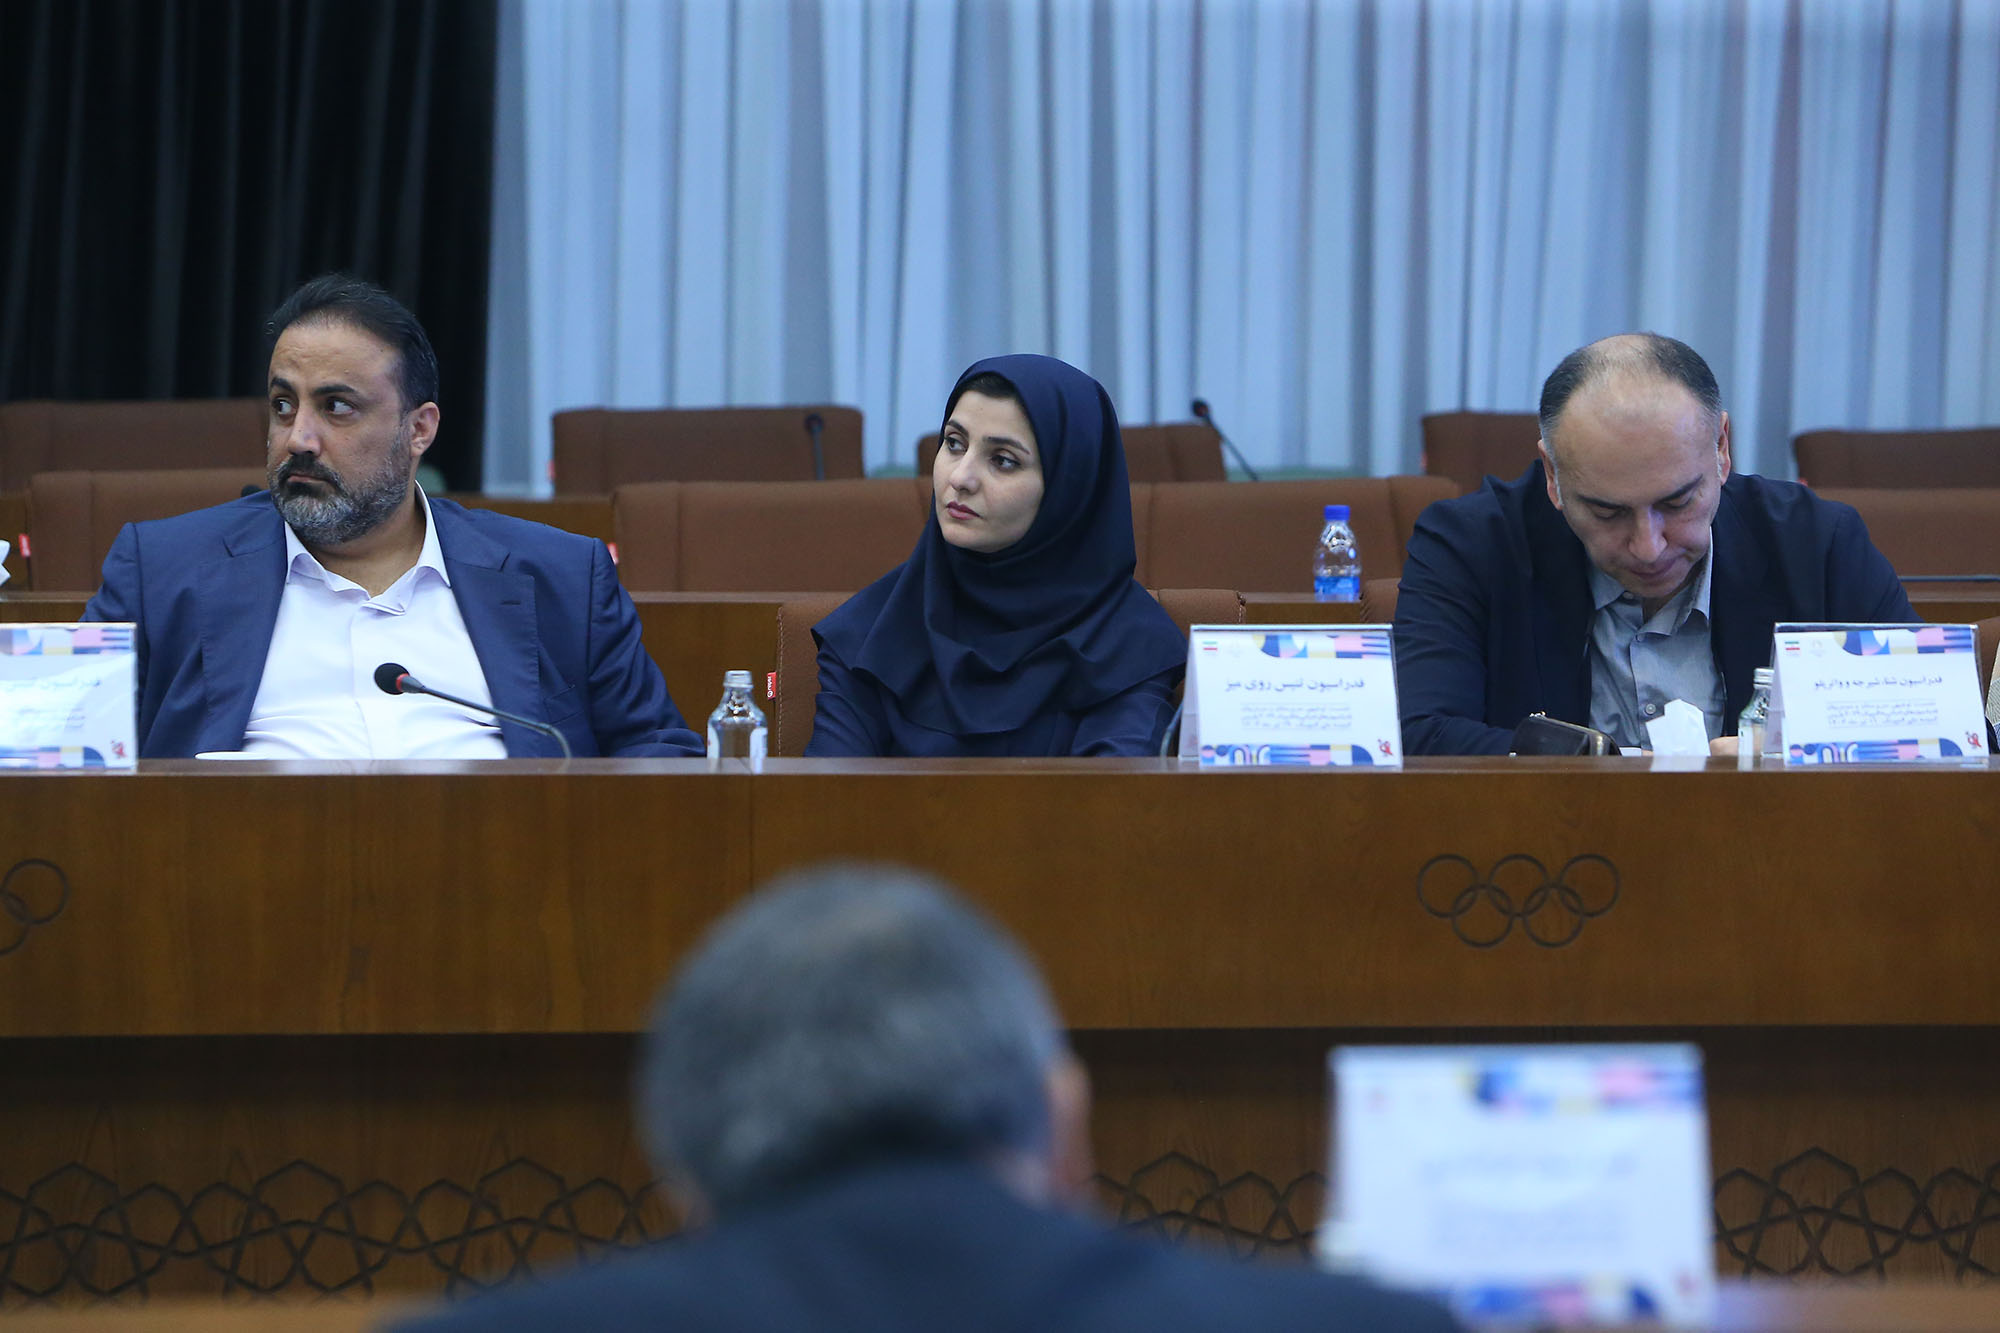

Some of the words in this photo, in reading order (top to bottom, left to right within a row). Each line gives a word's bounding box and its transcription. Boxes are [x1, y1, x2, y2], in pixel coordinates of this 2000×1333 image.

[1245, 679, 1272, 691] روی
[1274, 677, 1304, 693] تنیس
[1307, 677, 1365, 693] فدراسیون
[1899, 674, 1943, 689] فدراسیون
